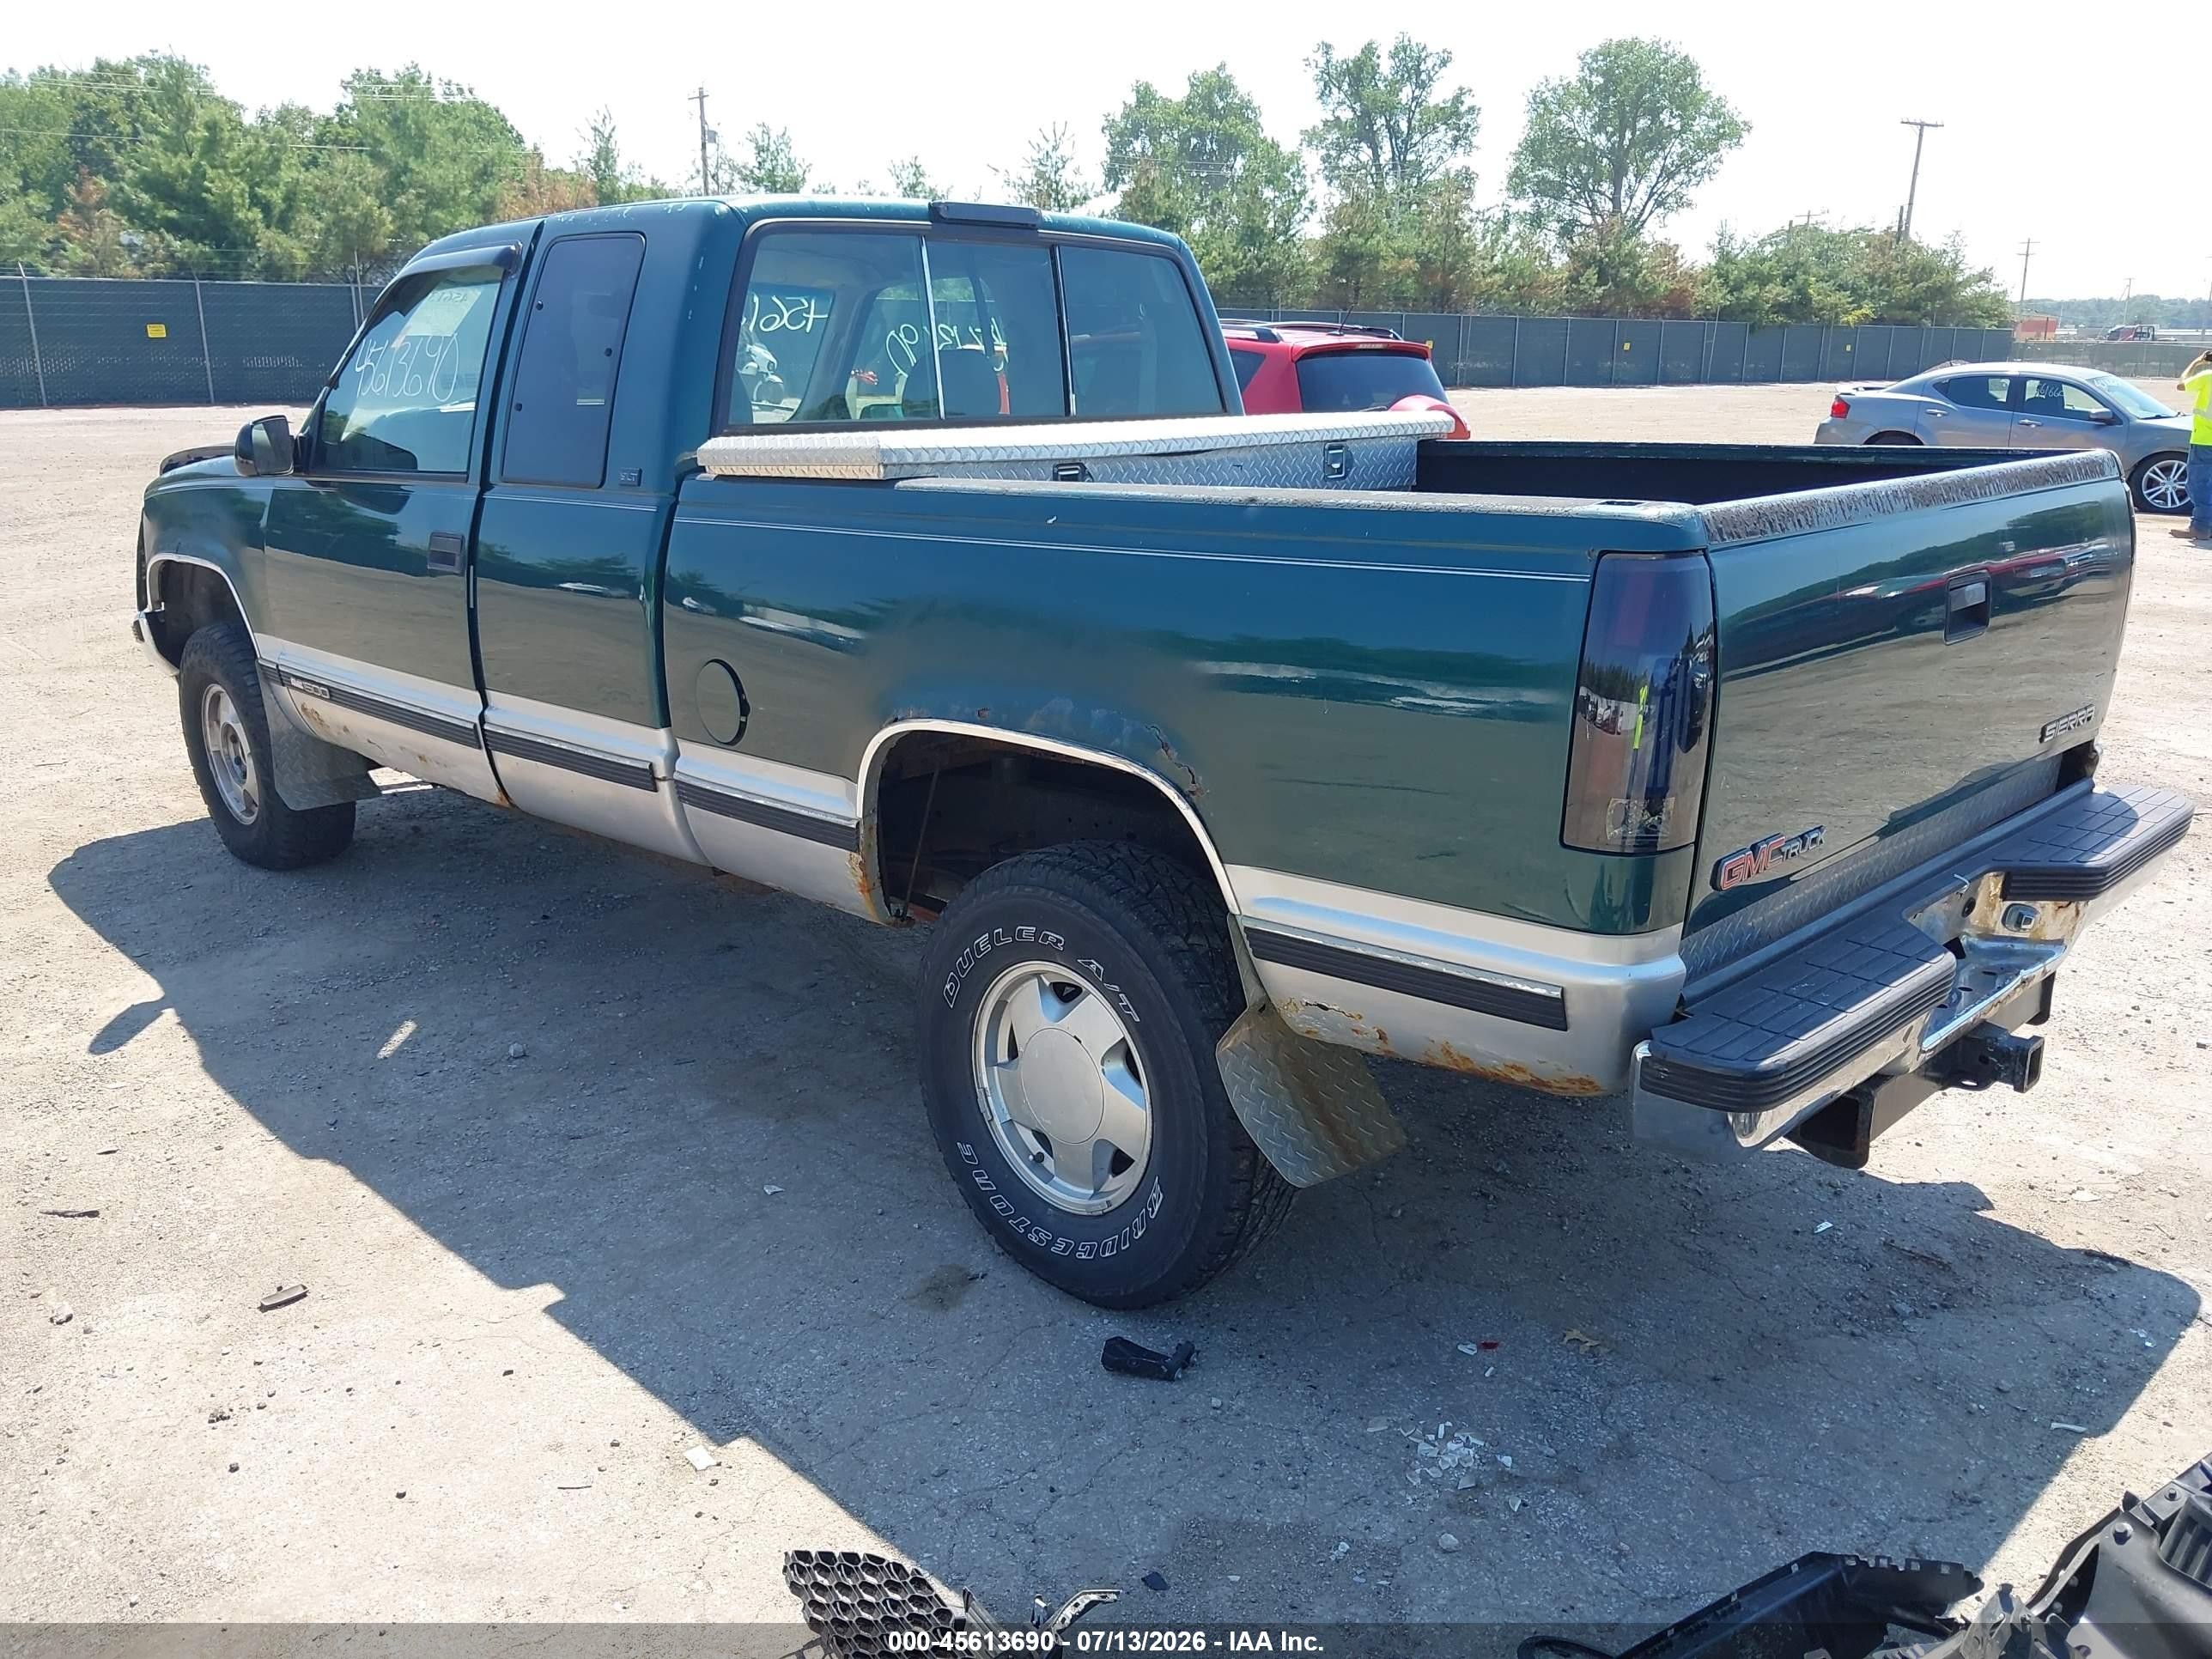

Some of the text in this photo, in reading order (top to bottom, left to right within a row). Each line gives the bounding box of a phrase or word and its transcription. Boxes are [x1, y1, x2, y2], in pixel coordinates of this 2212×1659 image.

[355, 332, 459, 402] 45613690
[2043, 704, 2096, 743] SIERRA
[1720, 828, 1826, 890] GMC TRUCK
[943, 926, 1140, 1022] DUELER A/T
[957, 1141, 1164, 1260] BRIDGESTONE
